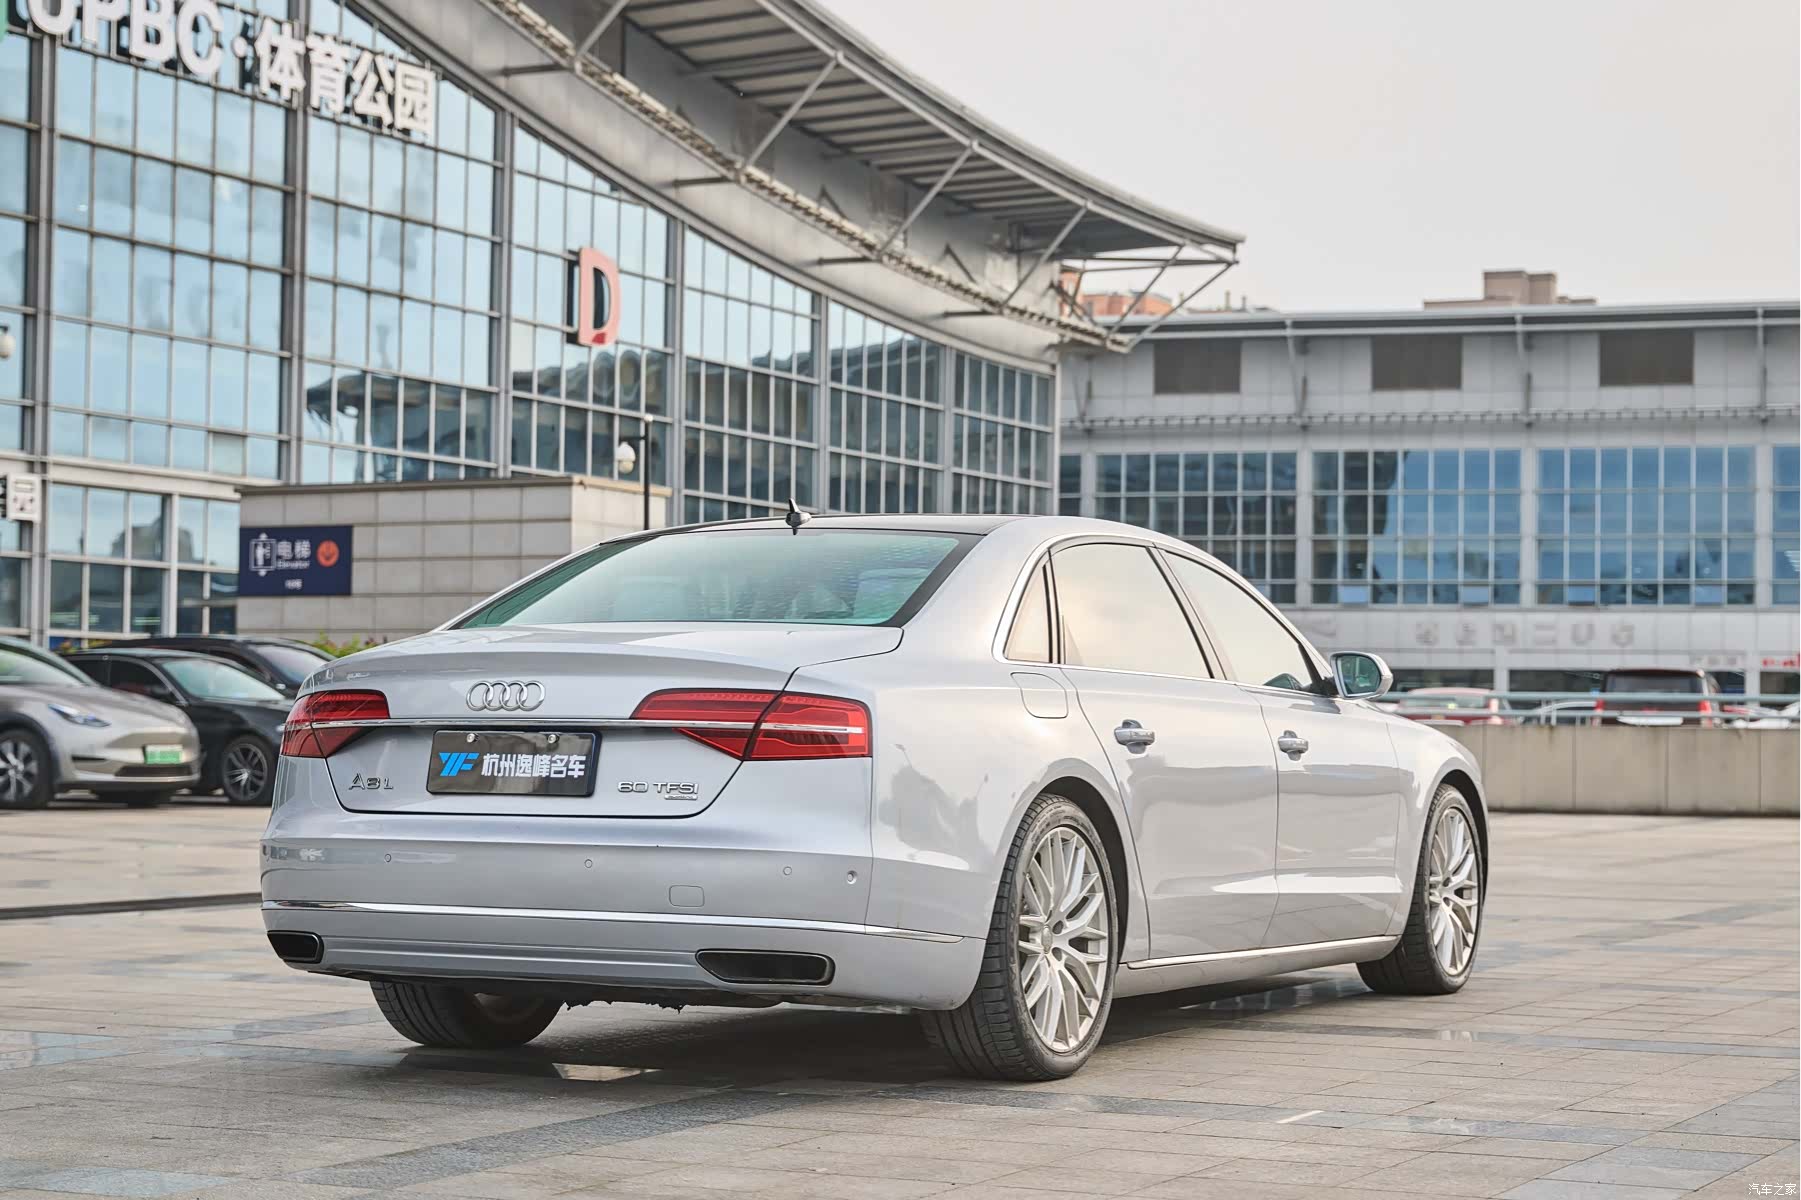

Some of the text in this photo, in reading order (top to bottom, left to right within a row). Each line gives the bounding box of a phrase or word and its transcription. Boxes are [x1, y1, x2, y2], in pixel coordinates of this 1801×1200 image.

[578, 246, 621, 346] D
[277, 539, 311, 560] 电梯
[617, 781, 699, 795] 60 TFSI
